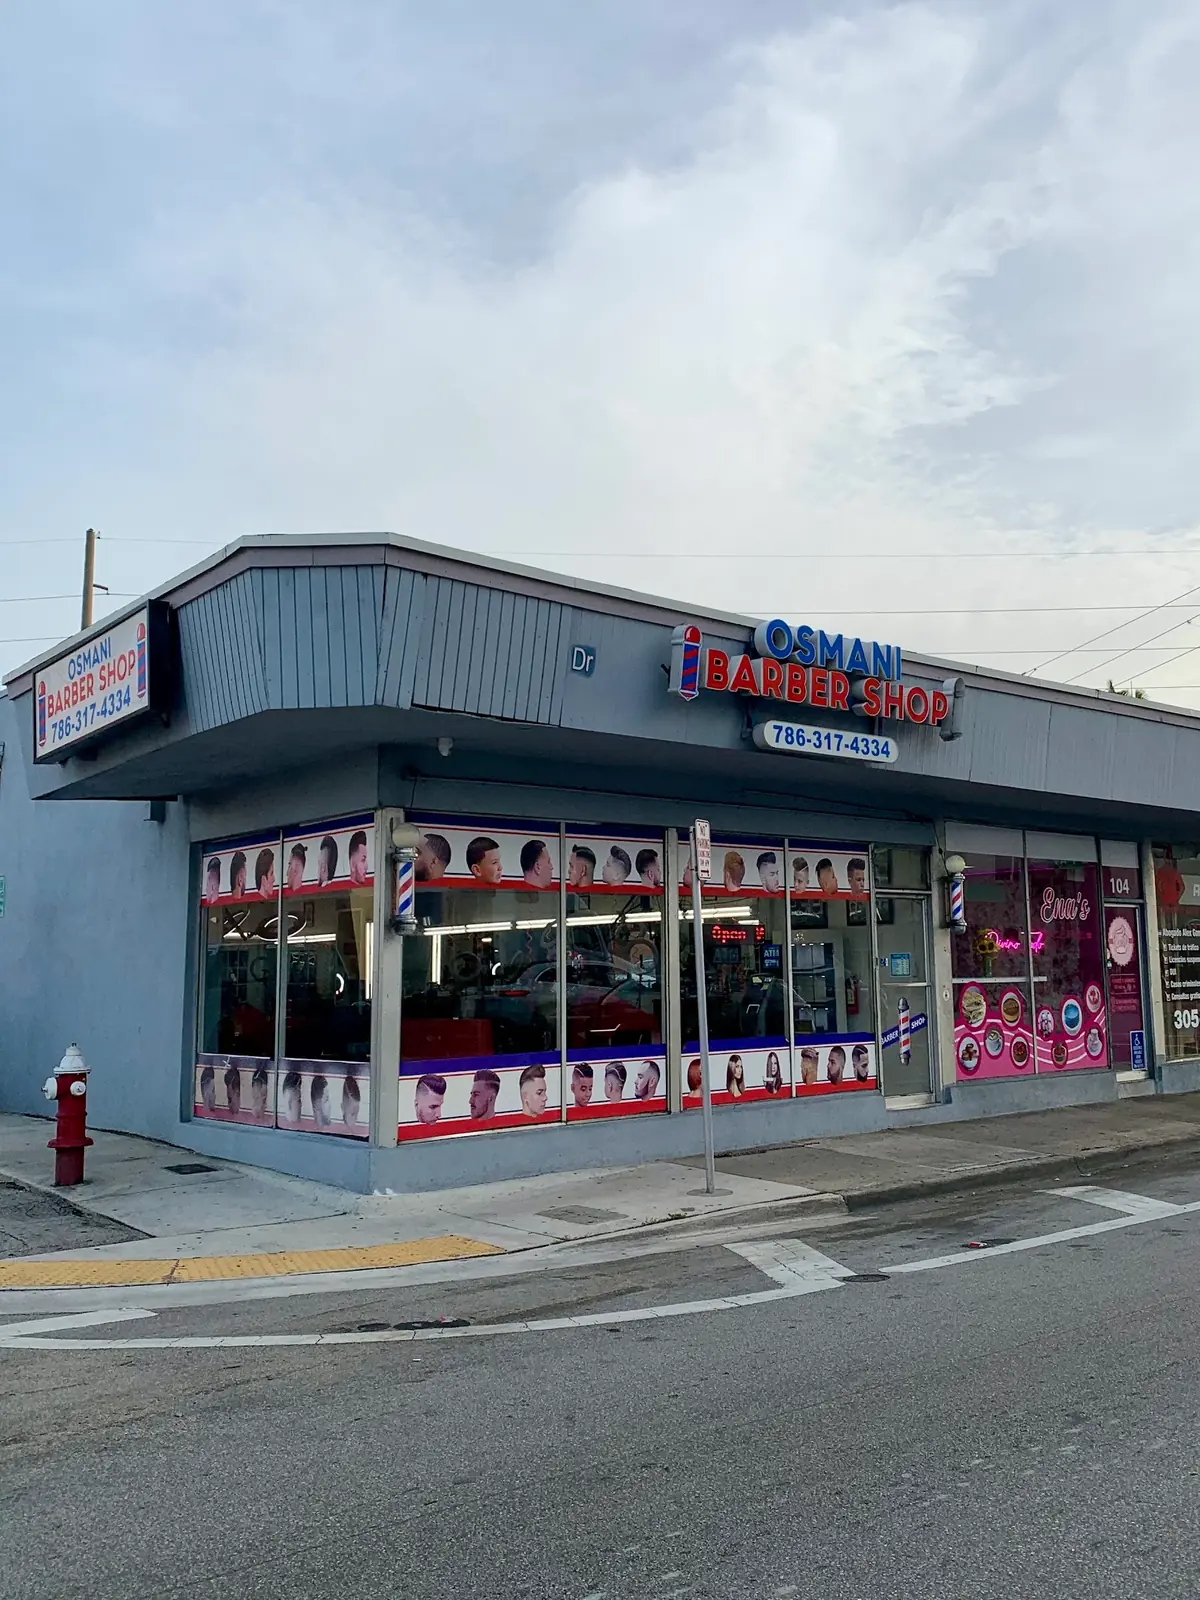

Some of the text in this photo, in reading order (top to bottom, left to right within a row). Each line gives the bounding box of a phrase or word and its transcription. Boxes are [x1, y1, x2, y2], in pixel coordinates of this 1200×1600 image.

[68, 637, 112, 680] OSMANI
[572, 646, 594, 671] Dr
[765, 618, 901, 681] OSMANI
[48, 649, 136, 718] BARBER SHOP
[705, 648, 949, 726] BARBER SHOP
[51, 685, 131, 743] 786-317-4334
[772, 724, 891, 758] 786-317-4334
[1110, 878, 1129, 894] 104
[1040, 887, 1090, 923] Ena's
[1162, 928, 1182, 938] Abogado
[1174, 1009, 1199, 1029] 305
